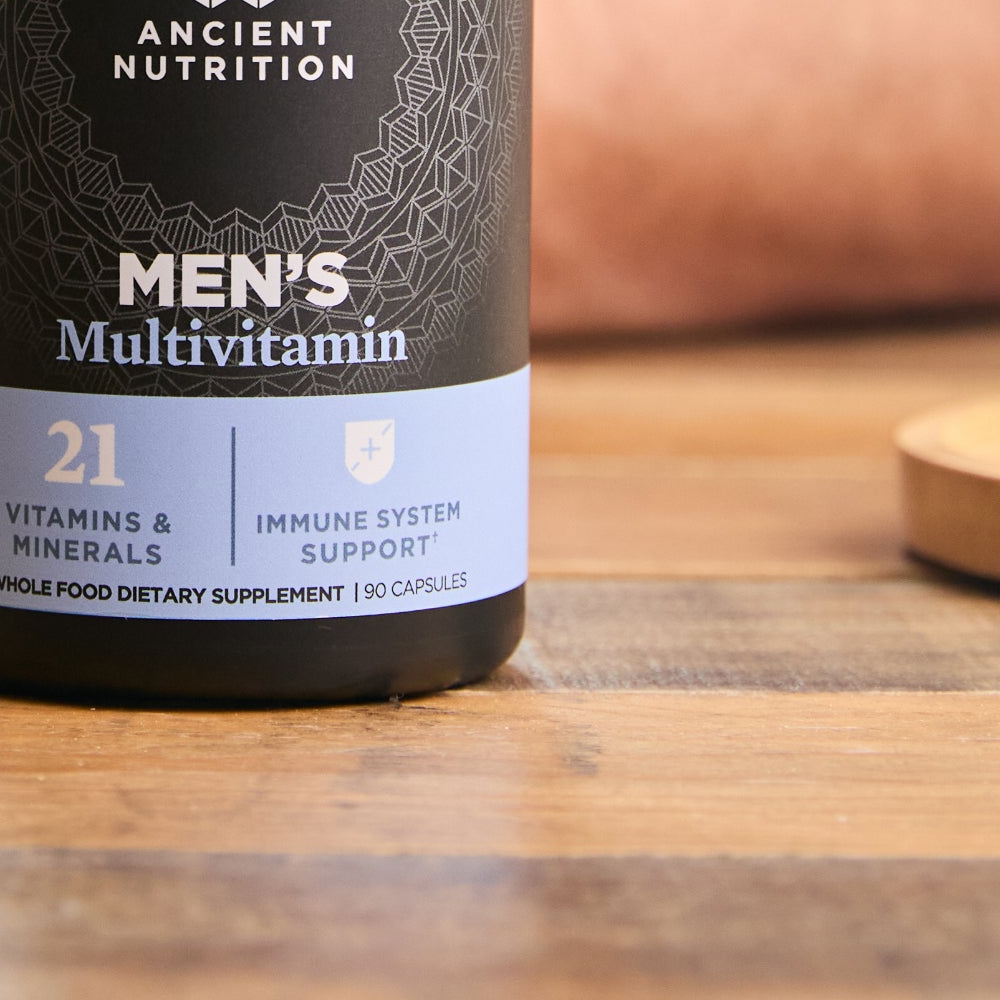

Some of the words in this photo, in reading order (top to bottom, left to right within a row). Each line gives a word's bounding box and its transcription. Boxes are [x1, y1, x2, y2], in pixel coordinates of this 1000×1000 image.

[137, 20, 333, 47] ANCIENT
[113, 54, 356, 81] NUTRITION
[55, 314, 408, 368] Multivitamin
[43, 420, 125, 488] 21
[5, 502, 142, 534] VITAMINS
[153, 512, 172, 535] &
[256, 511, 368, 534] IMMUNE
[376, 500, 461, 529] SYSTEM
[12, 535, 162, 566] MINERALS
[56, 581, 112, 601] FOOD
[117, 585, 207, 604] DIETARY
[211, 585, 345, 604] SUPPLEMENT
[364, 582, 387, 600] 90
[391, 571, 468, 598] CAPSULES
